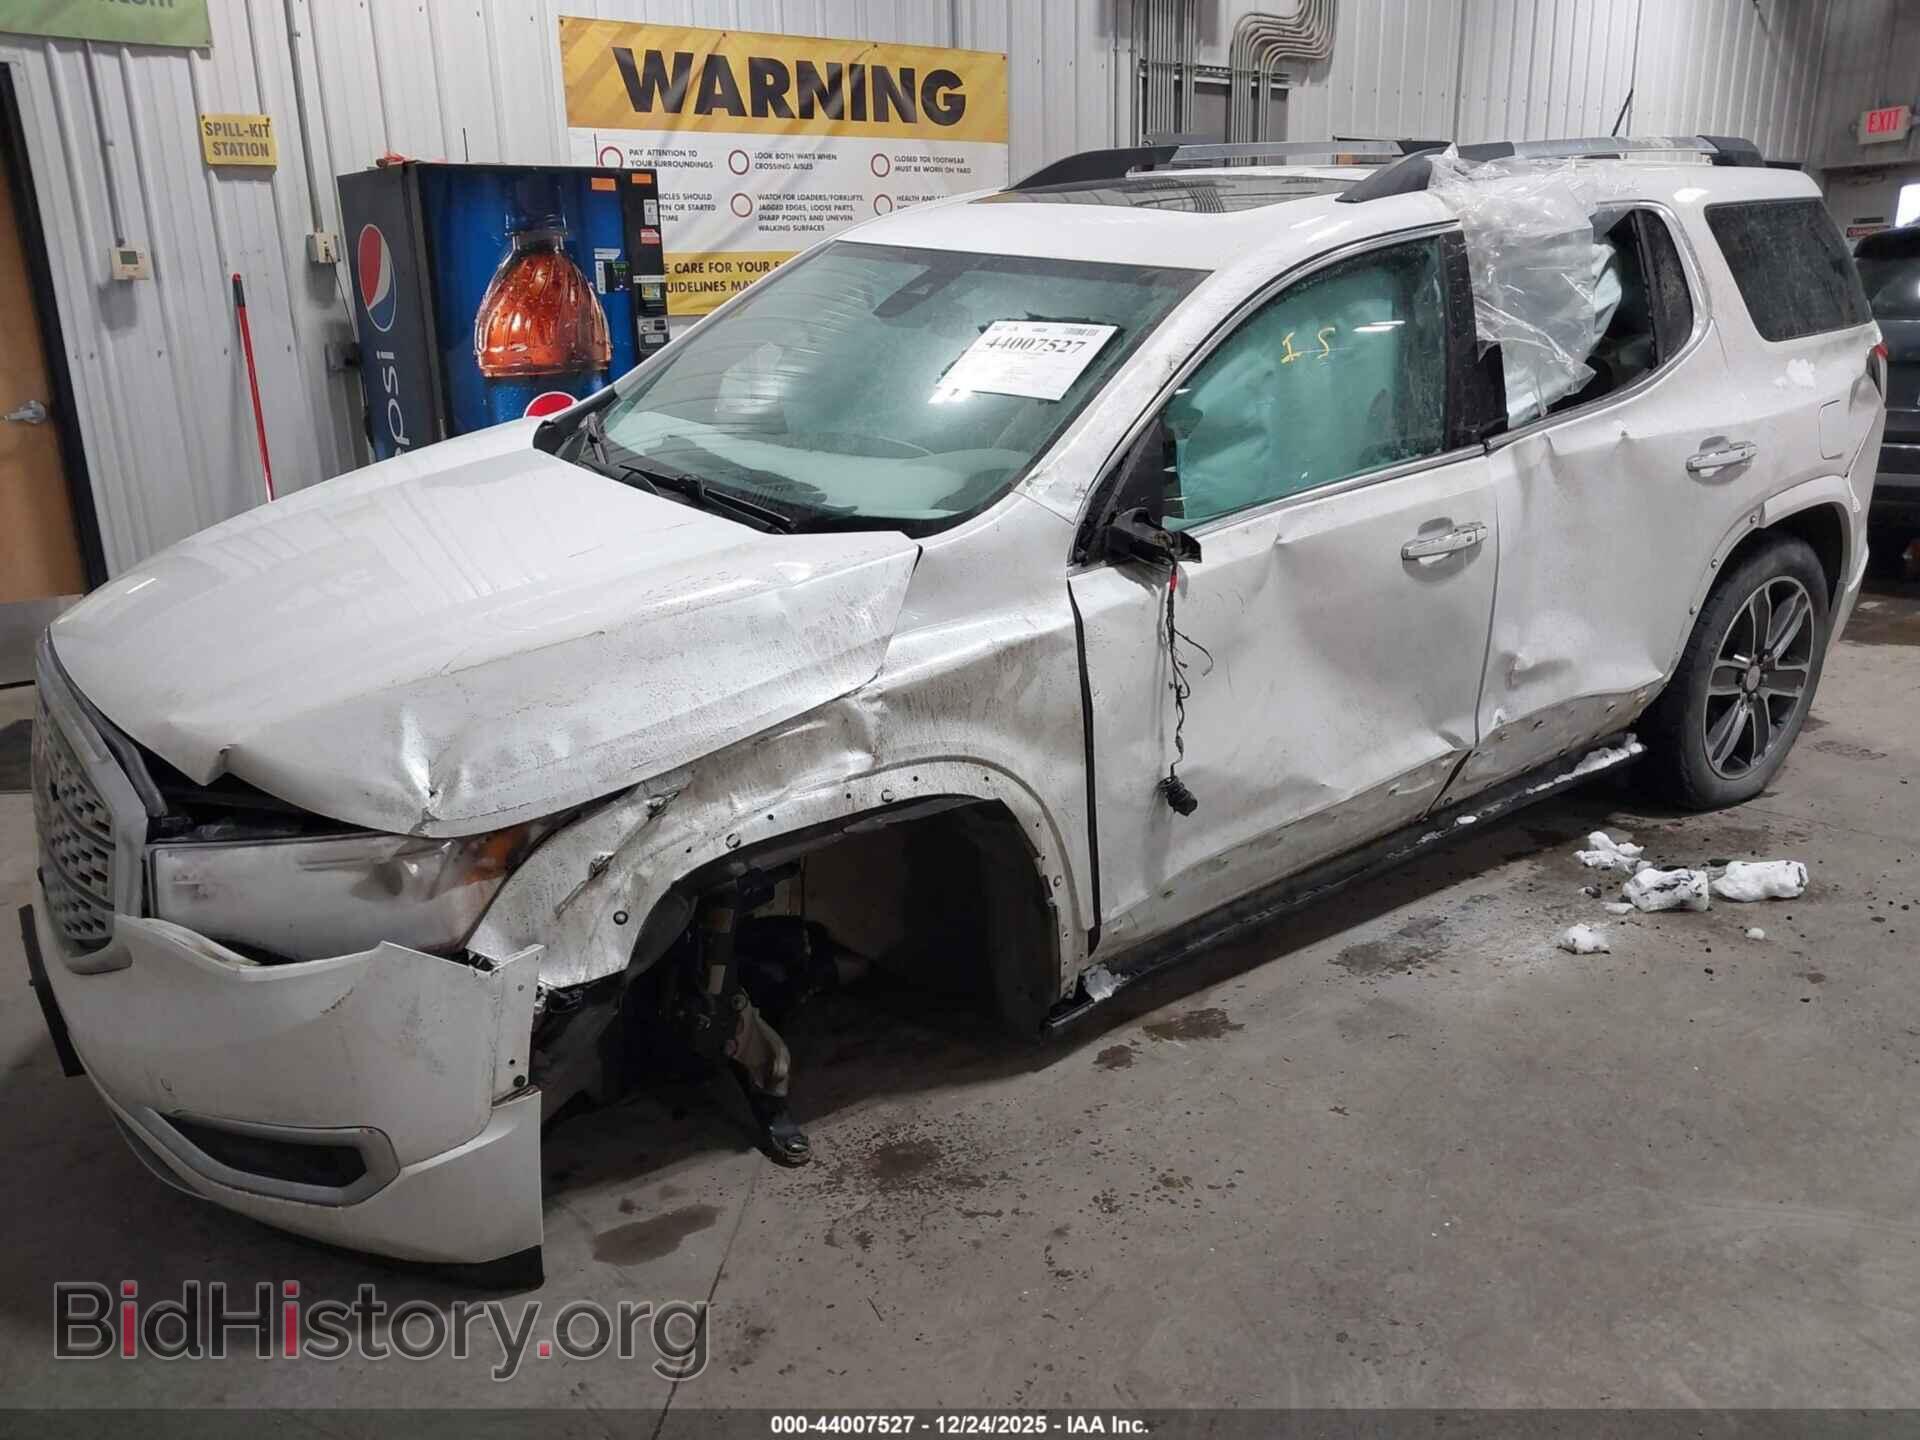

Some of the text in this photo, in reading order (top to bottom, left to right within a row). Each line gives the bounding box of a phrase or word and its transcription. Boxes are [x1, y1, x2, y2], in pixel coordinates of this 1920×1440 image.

[612, 47, 966, 126] WARNING
[1868, 108, 1902, 133] EXIT
[205, 121, 271, 138] SPILL-KIT
[212, 142, 269, 157] STATION
[647, 149, 686, 157] ATTENTION
[754, 152, 773, 160] LOOK
[775, 152, 794, 160] BOTH
[817, 153, 837, 161] WHEN
[894, 155, 918, 163] CLOSED
[631, 160, 714, 169] YOUR SURROUNDINGS
[682, 193, 713, 201] SHOULD
[687, 204, 717, 212] STARTED
[674, 262, 704, 274] CARE
[708, 261, 732, 273] FOR
[736, 261, 771, 273] YOUR
[985, 335, 1088, 355] 44007527
